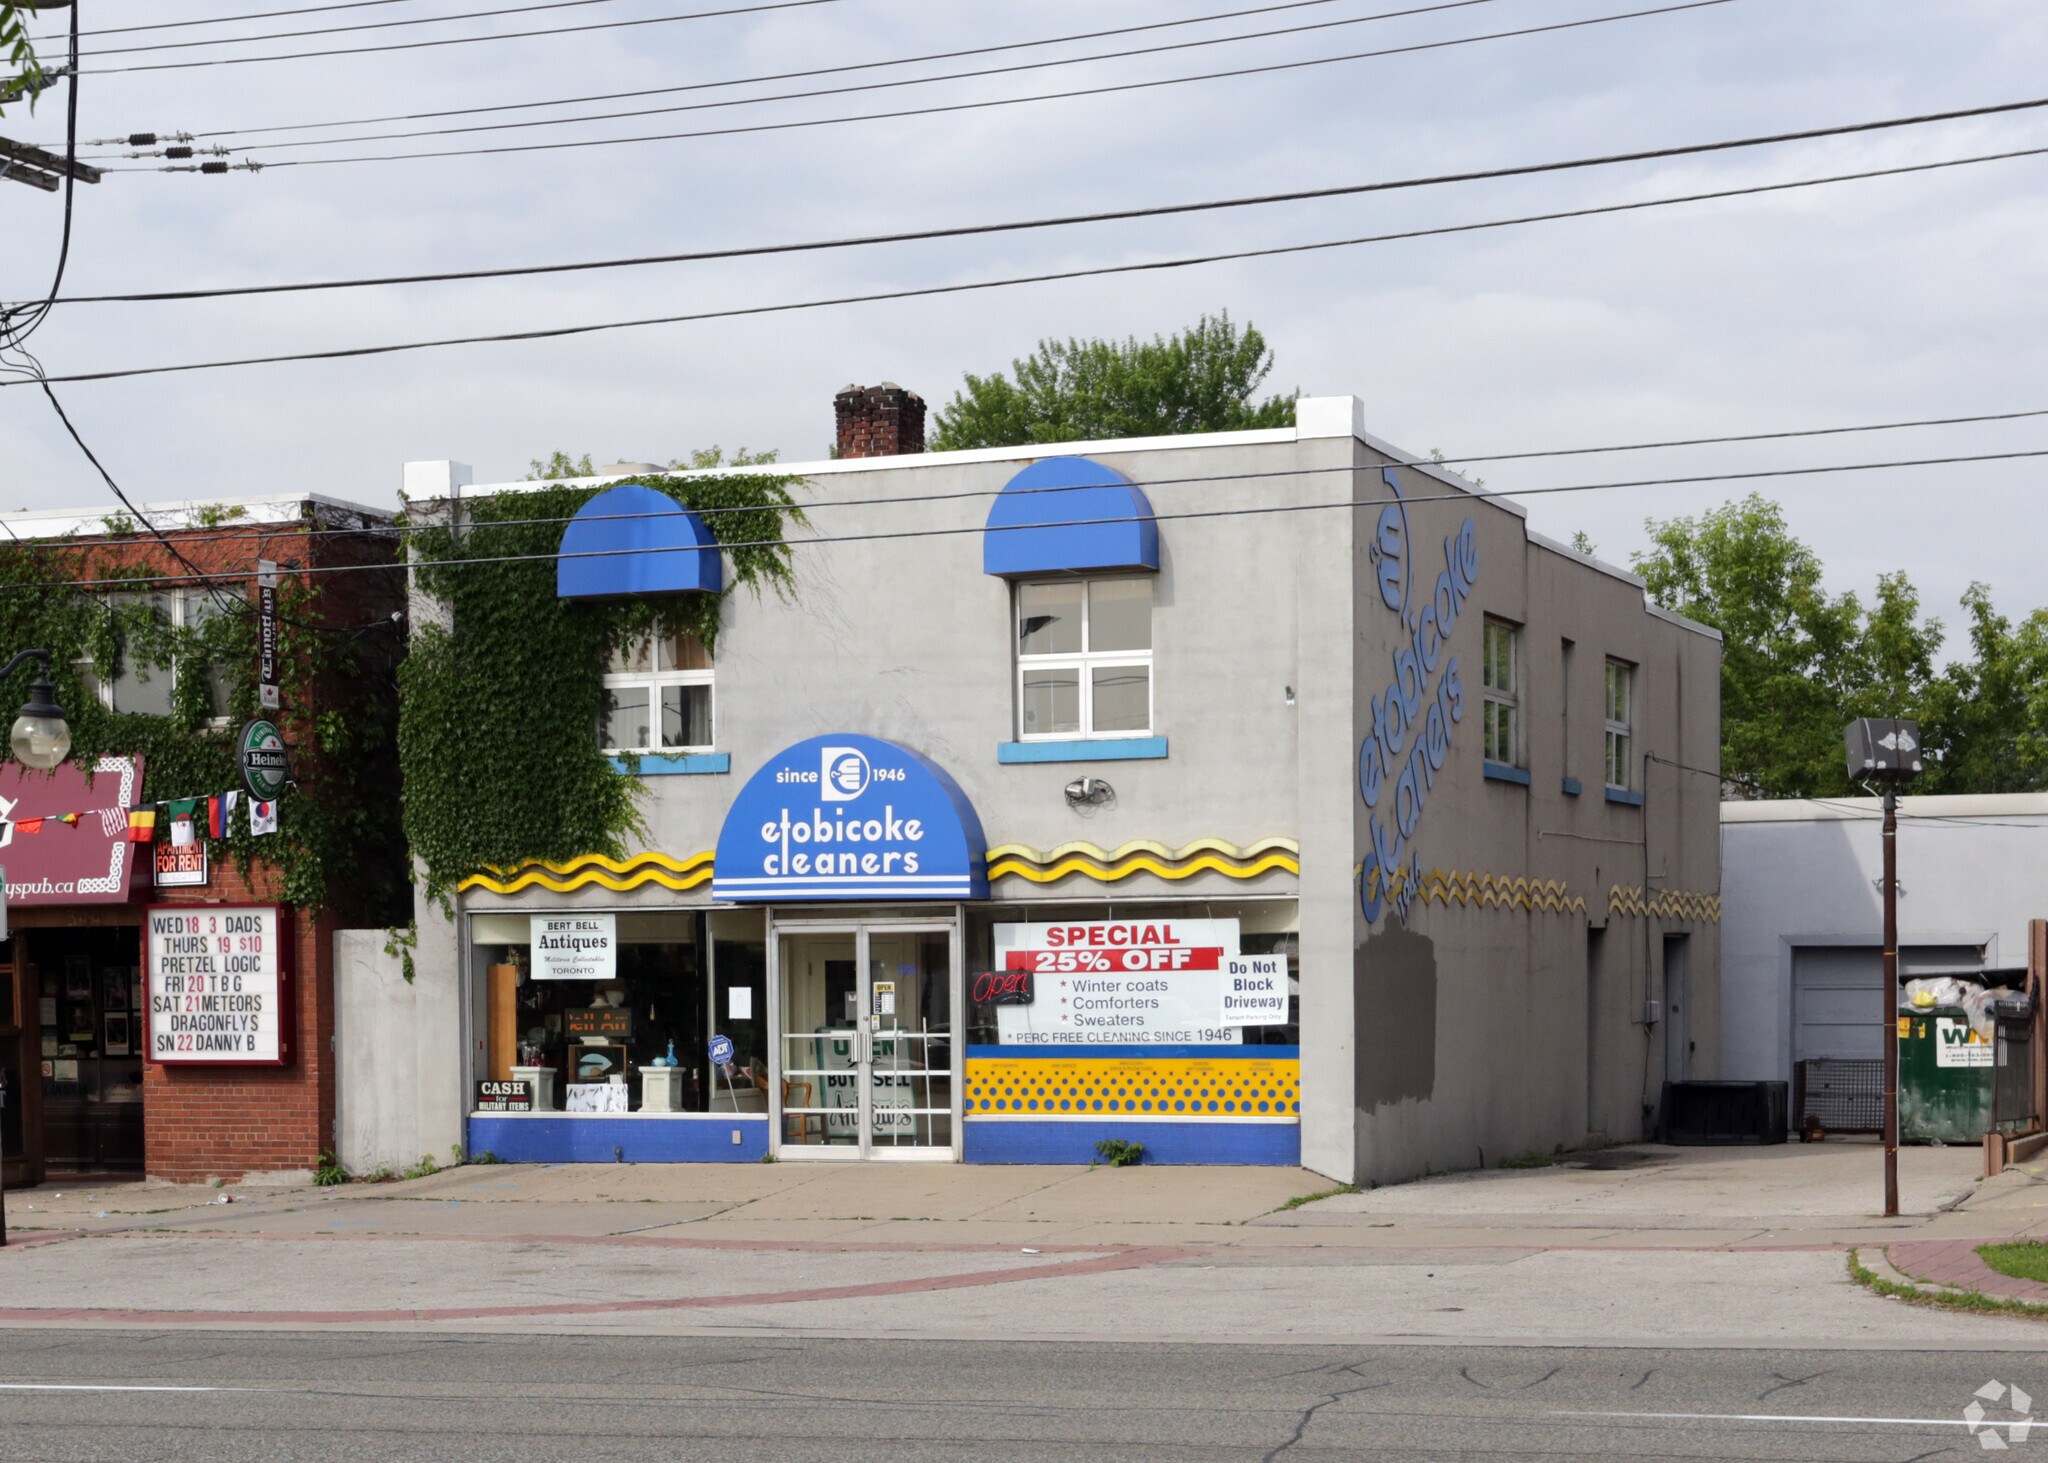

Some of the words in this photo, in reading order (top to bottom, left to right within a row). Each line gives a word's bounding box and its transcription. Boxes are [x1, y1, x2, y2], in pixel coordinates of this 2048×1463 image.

[1360, 515, 1480, 808] etobicoke
[776, 767, 818, 784] since
[872, 768, 906, 782] 1946
[1360, 656, 1465, 924] cleaners
[760, 804, 925, 843] etobicoke
[157, 856, 176, 872] FOR
[178, 853, 203, 871] RENT
[763, 849, 920, 876] cleaners
[4, 877, 75, 899] yspub.ca
[153, 917, 183, 934] WED
[185, 916, 199, 934] 18
[209, 916, 217, 934] 3
[225, 916, 262, 933] DADS
[547, 922, 571, 930] BERT
[576, 921, 598, 930] BELL
[538, 934, 608, 952] Antiques
[1046, 925, 1180, 947] SPECIAL
[164, 936, 208, 954] THURS
[217, 936, 231, 953] 19
[239, 936, 262, 953] $10
[161, 956, 216, 973] PRETZEL
[224, 955, 261, 973] LOGIC
[1035, 950, 1112, 972] 25%
[1122, 948, 1192, 970] OFF
[1229, 961, 1247, 974] Do
[1253, 960, 1277, 973] Not
[165, 976, 184, 992] FRI
[188, 975, 204, 992] 20
[973, 972, 1028, 1003] Open
[1072, 979, 1121, 993] Winter
[1126, 979, 1168, 992] coats
[1234, 978, 1274, 991] Block
[153, 996, 181, 1013] SAT
[185, 995, 200, 1012] 21
[202, 994, 262, 1012] METEORS
[1073, 996, 1159, 1010] Comforters
[1224, 995, 1283, 1010] Driveway
[170, 1014, 259, 1031] DRAGONFLYS
[1074, 1013, 1145, 1027] Sweaters
[157, 1034, 175, 1052] SN
[177, 1034, 193, 1051] 22
[196, 1034, 242, 1051] DANNY
[247, 1034, 255, 1051] B
[1016, 1032, 1049, 1043] PERC
[1053, 1032, 1083, 1043] FREE
[1087, 1031, 1150, 1043] CLEANING
[1154, 1030, 1192, 1042] SINCE
[1197, 1028, 1232, 1042] 1946
[713, 1043, 728, 1057] ADT
[834, 1039, 897, 1056] OEN
[481, 1082, 525, 1095] CASH
[478, 1101, 507, 1111] MILITARY
[508, 1101, 529, 1111] ITEMS
